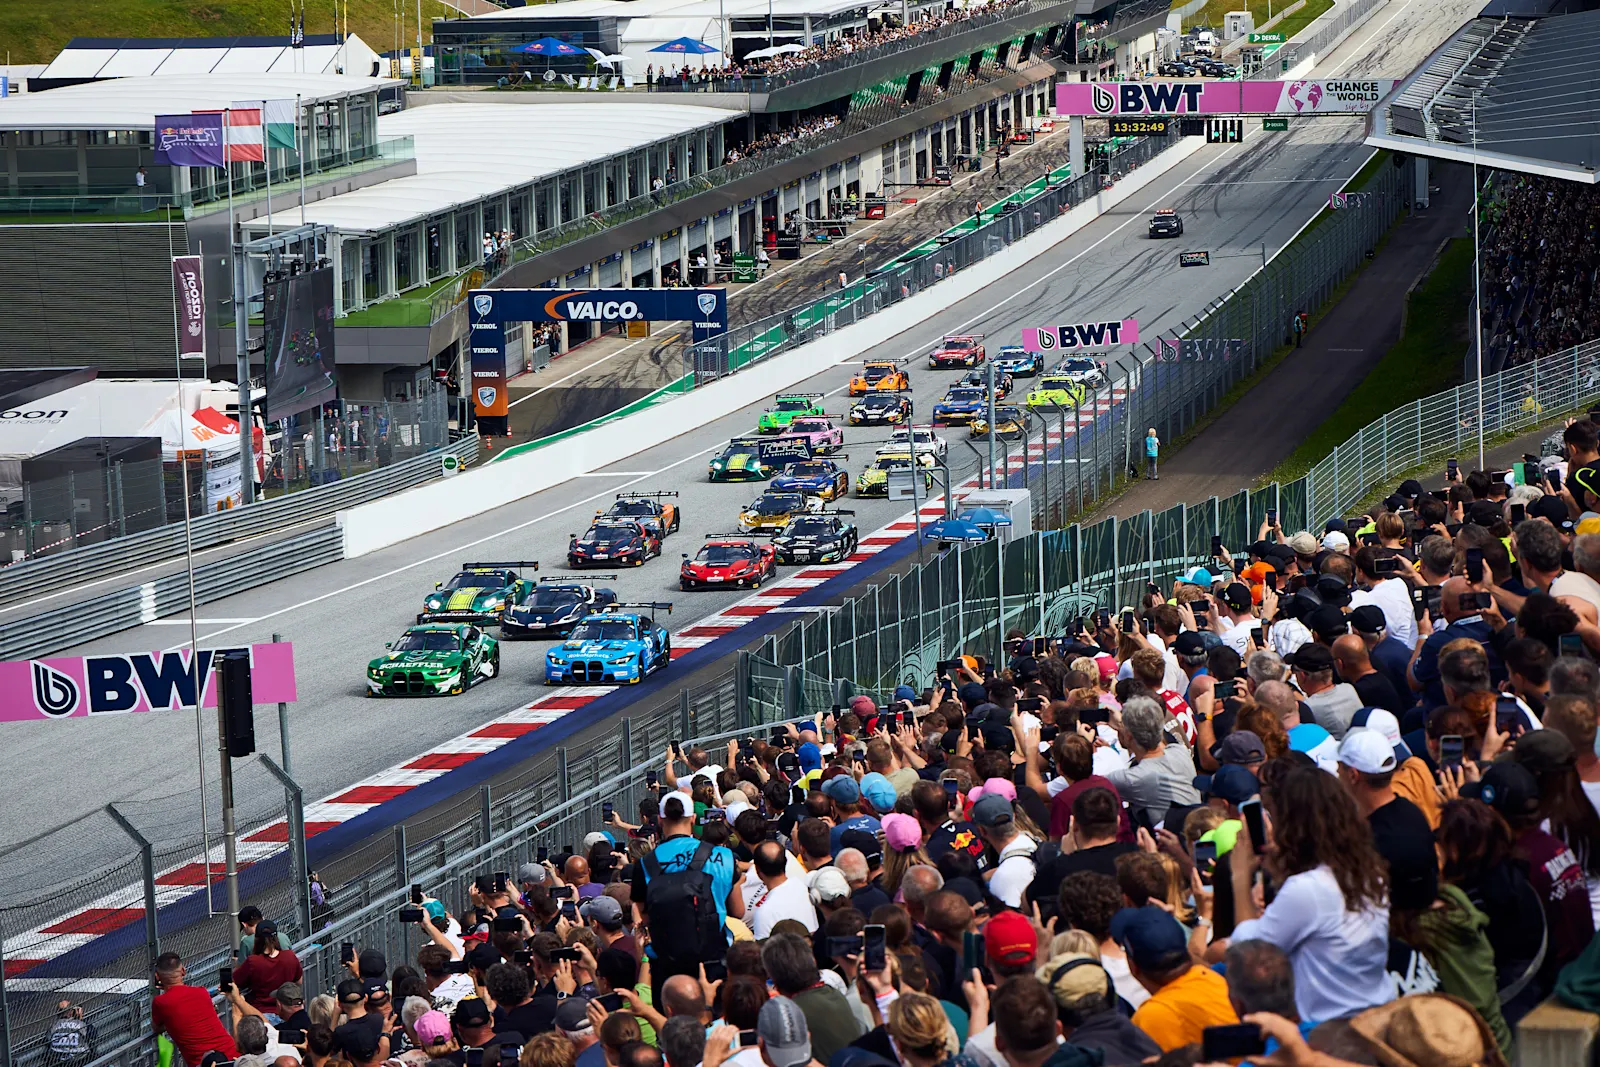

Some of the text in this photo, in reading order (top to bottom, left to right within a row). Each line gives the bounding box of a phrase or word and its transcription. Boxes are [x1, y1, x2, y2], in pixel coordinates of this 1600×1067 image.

[1326, 82, 1378, 91] CHANGE
[1120, 84, 1203, 112] BWT
[1337, 92, 1379, 101] WORLD
[1114, 122, 1165, 132] 13:32:49
[1058, 322, 1122, 348] BWT
